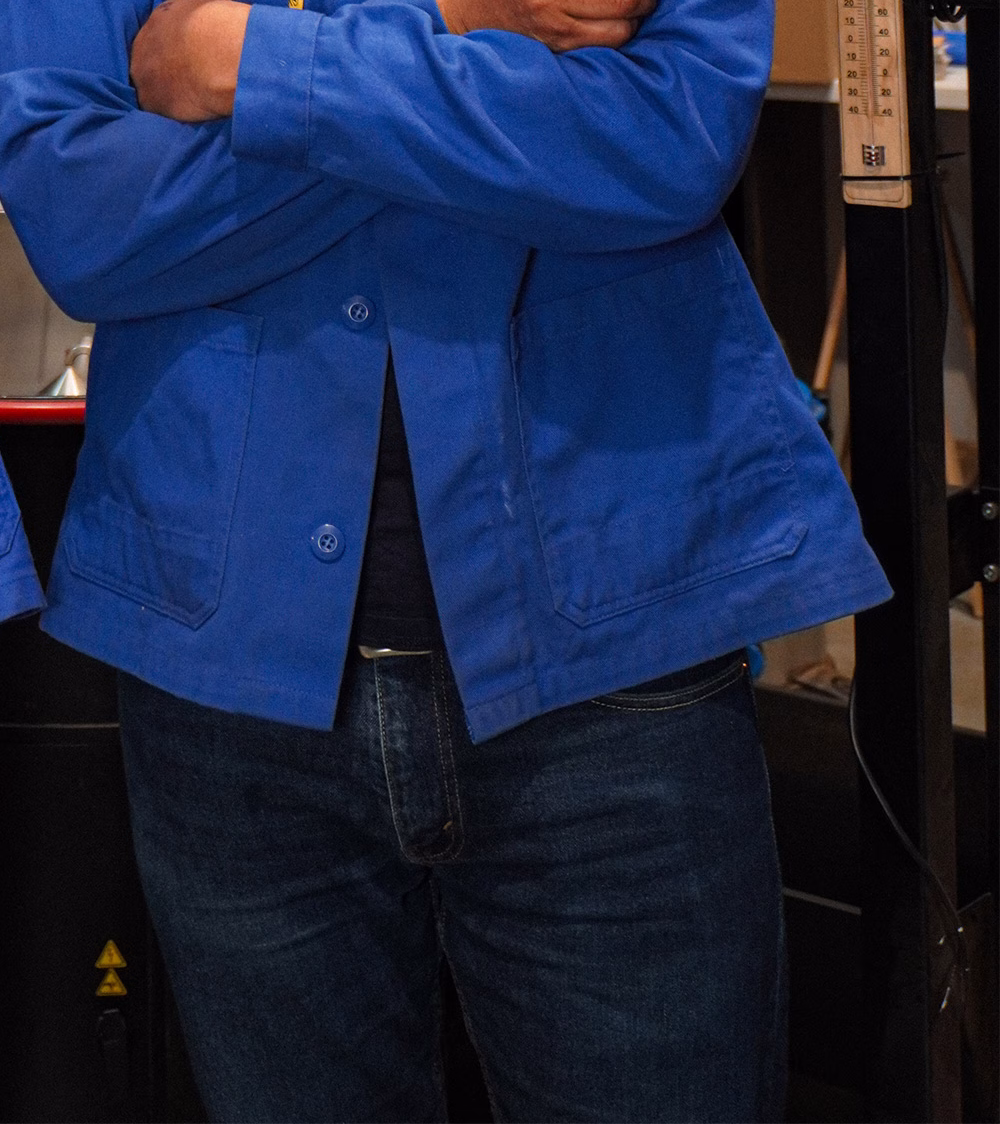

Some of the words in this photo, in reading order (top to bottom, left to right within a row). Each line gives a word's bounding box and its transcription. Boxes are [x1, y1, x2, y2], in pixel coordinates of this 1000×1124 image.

[844, 0, 854, 7] 20
[877, 8, 888, 16] 60
[879, 28, 889, 36] 40
[880, 48, 890, 56] 20
[847, 70, 857, 78] 20
[848, 88, 858, 96] 30
[881, 88, 891, 96] 20
[849, 106, 859, 114] 40
[882, 108, 892, 116] 40
